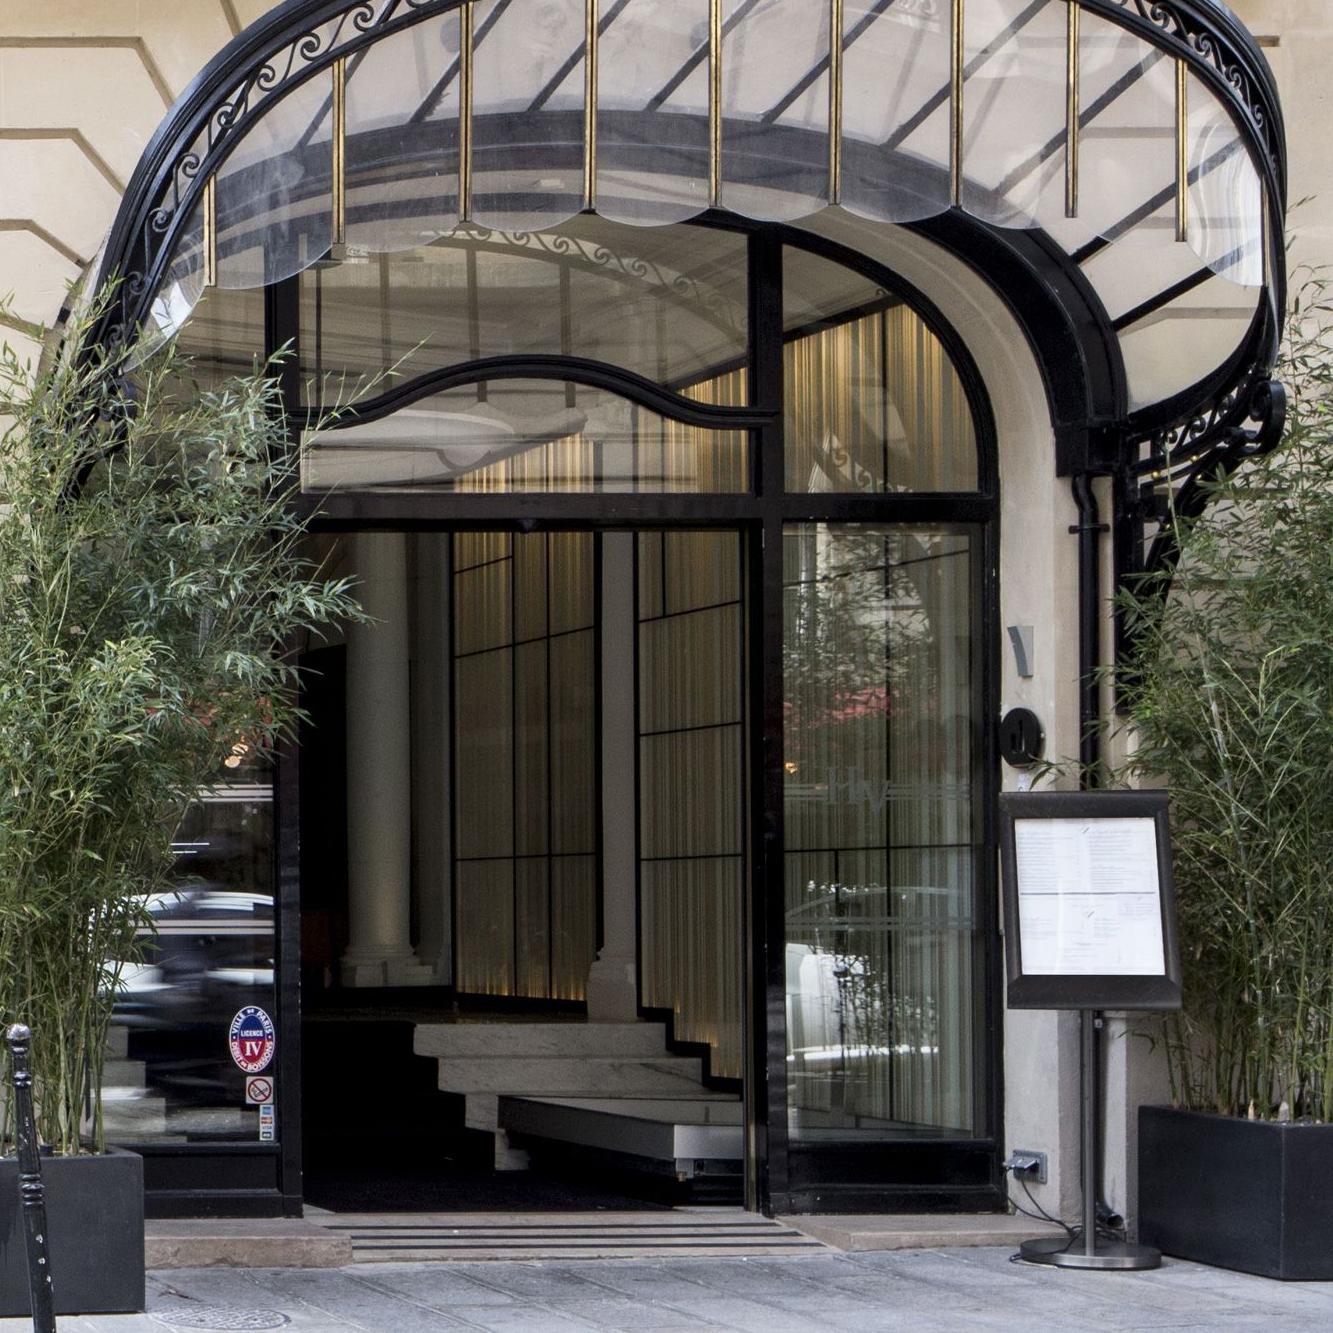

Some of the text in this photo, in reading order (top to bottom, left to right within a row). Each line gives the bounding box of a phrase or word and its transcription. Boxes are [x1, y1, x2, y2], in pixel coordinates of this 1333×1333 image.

[231, 1011, 246, 1035] VILLE
[256, 1011, 273, 1035] PARIS
[240, 1029, 264, 1037] LICENCE
[244, 1040, 263, 1057] IV
